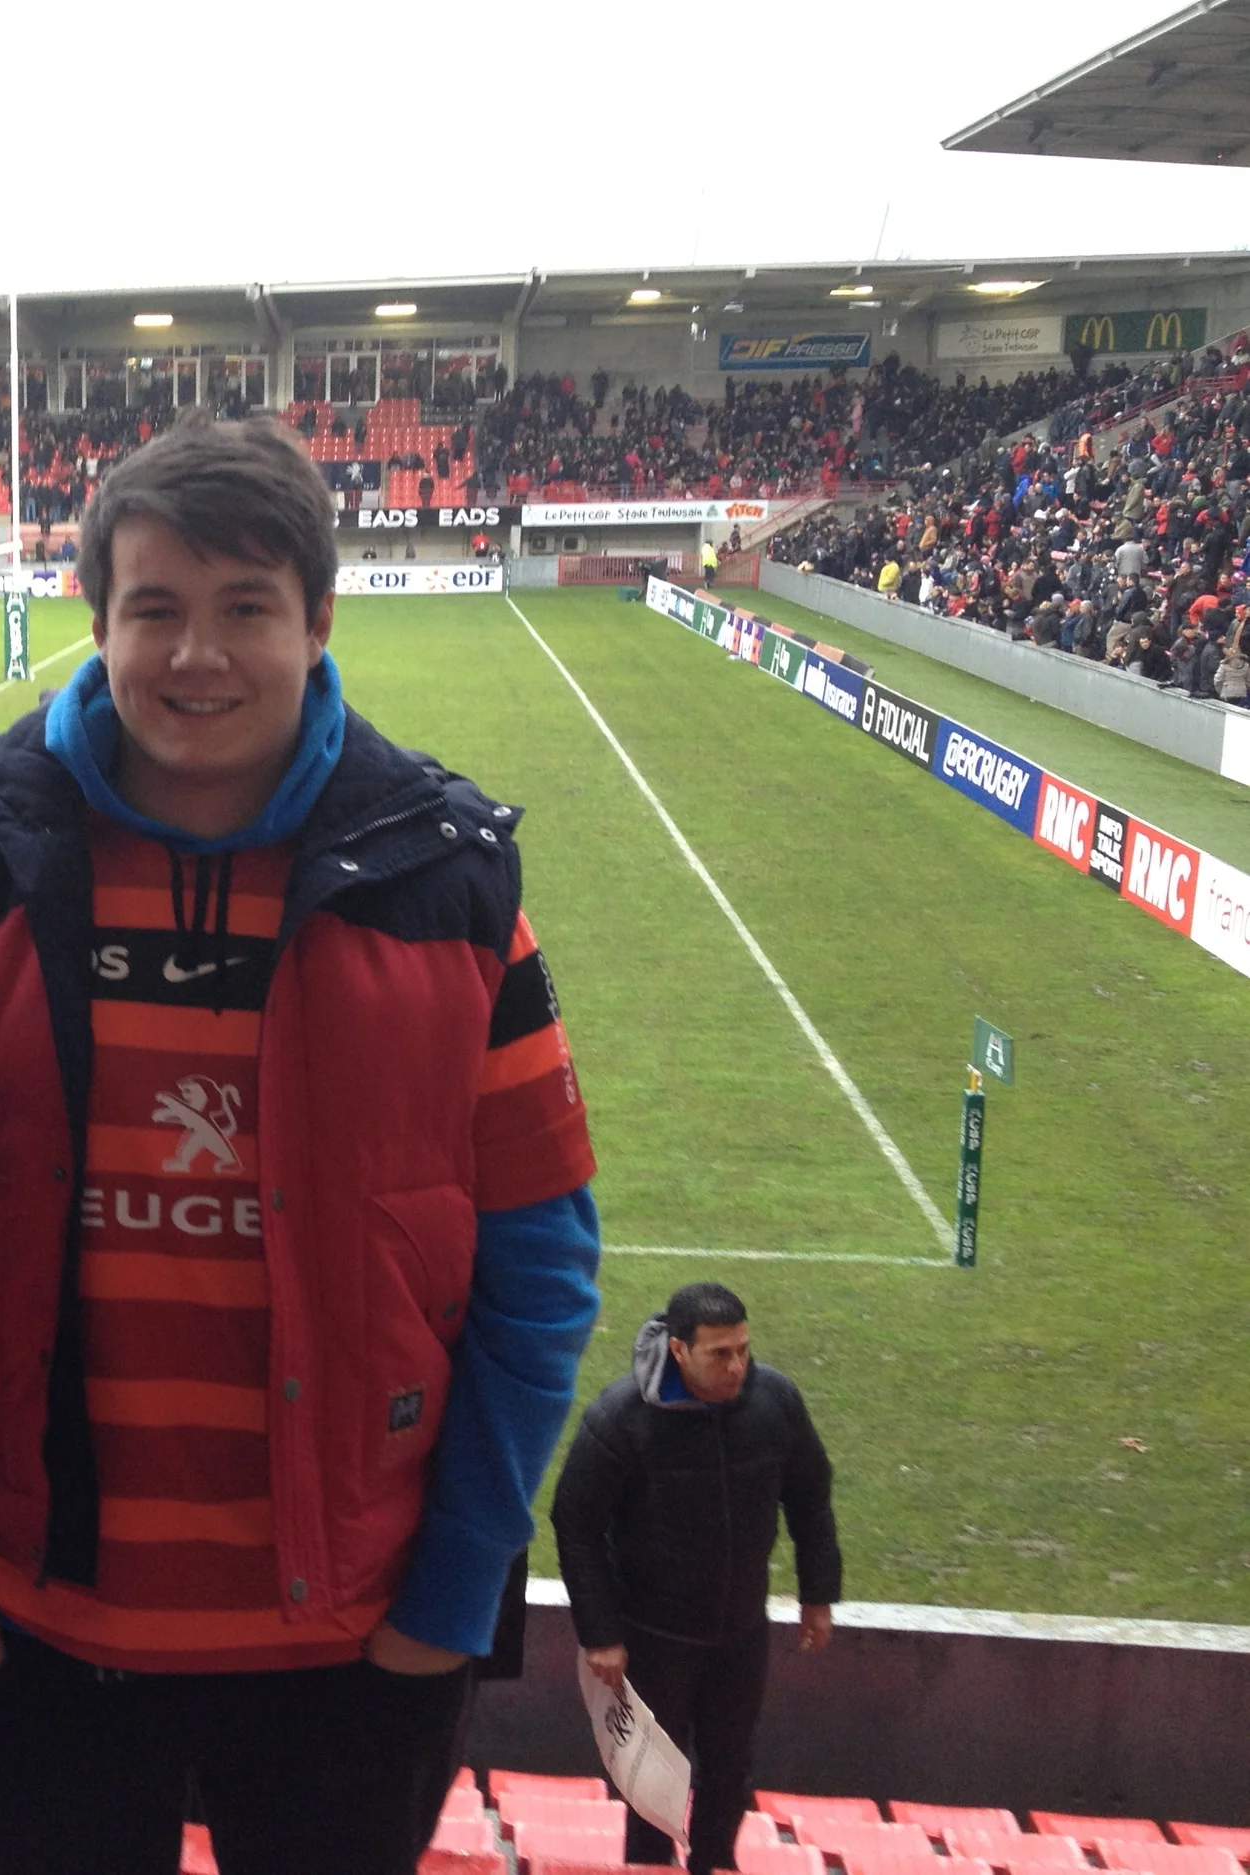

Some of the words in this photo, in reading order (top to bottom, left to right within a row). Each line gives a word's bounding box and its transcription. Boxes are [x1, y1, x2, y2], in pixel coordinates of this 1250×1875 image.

[358, 508, 419, 529] EADS
[438, 507, 500, 527] EADS
[875, 697, 929, 763] FIDUCIAL
[942, 731, 1030, 810] @ERCRUGBY
[1039, 783, 1090, 860] RMC
[1097, 832, 1122, 862] TALK
[1099, 813, 1123, 842] INFO
[1090, 848, 1124, 884] SPORT
[1128, 832, 1192, 921] RMC
